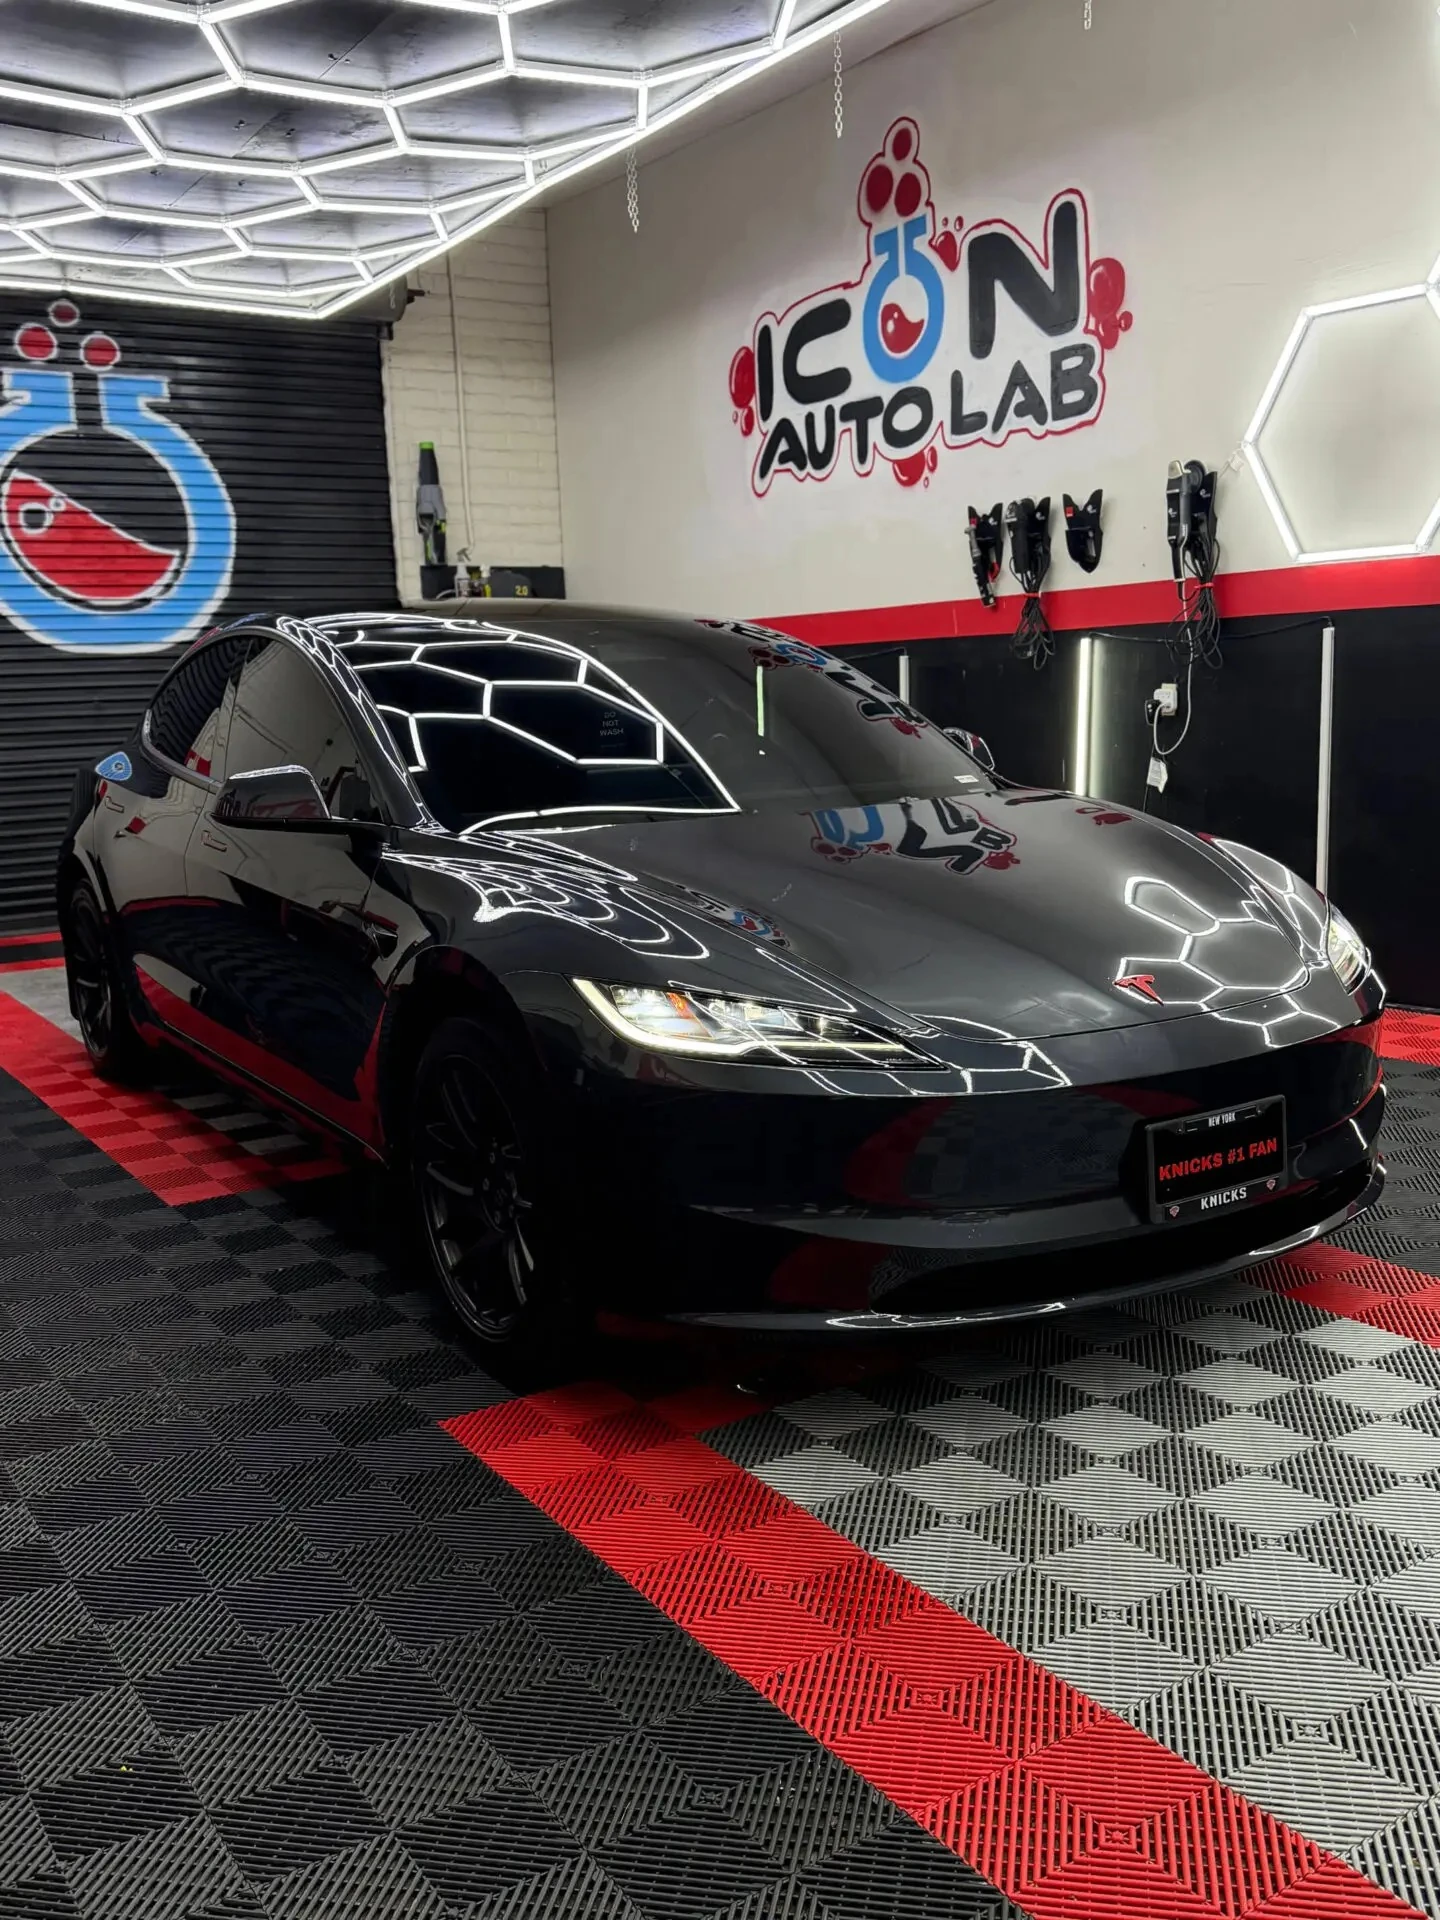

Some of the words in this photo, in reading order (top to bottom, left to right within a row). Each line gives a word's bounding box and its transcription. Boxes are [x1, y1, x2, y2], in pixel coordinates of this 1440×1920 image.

[756, 200, 1078, 422] ICON
[760, 386, 933, 479] AUTO
[950, 343, 1099, 436] LAB
[599, 728, 624, 736] WASH
[602, 719, 619, 727] NOT
[1208, 1114, 1220, 1127] NEW
[1221, 1112, 1236, 1124] YORK
[1159, 1153, 1223, 1181] KNICKS
[1227, 1147, 1245, 1163] #1
[1250, 1138, 1277, 1158] FAN
[1201, 1187, 1247, 1210] KNICKS
